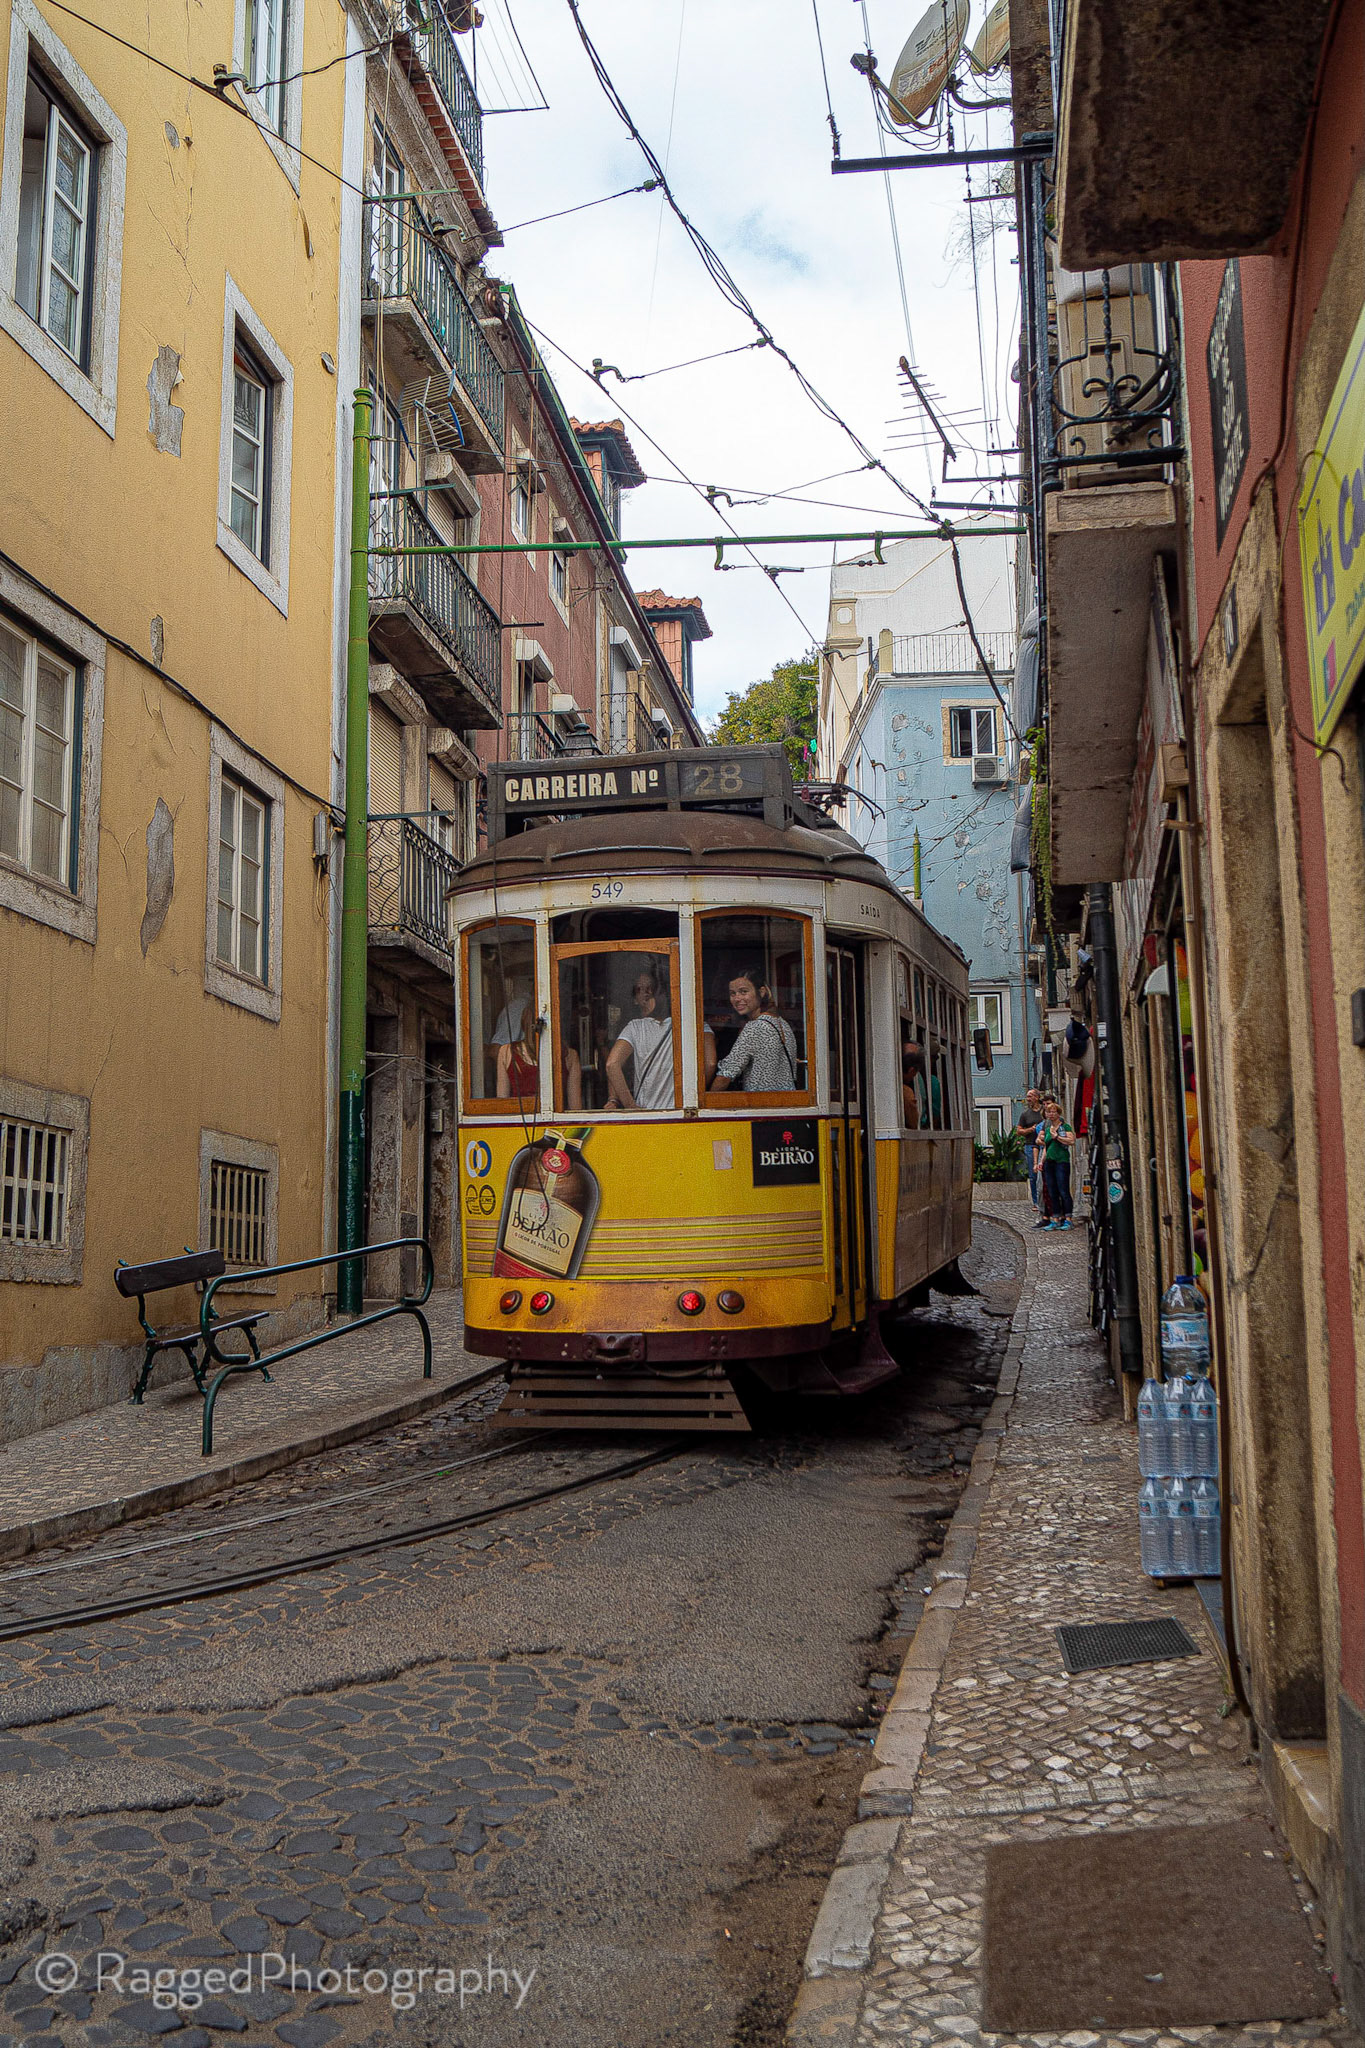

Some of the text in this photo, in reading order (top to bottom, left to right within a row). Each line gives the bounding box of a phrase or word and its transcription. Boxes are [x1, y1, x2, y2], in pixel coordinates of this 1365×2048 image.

[505, 762, 743, 802] CARREIRA Nº 28
[591, 881, 623, 898] 549
[860, 903, 881, 919] SAÍDA
[759, 1148, 815, 1166] BEIRÃO
[512, 1211, 570, 1249] BEIRÃO
